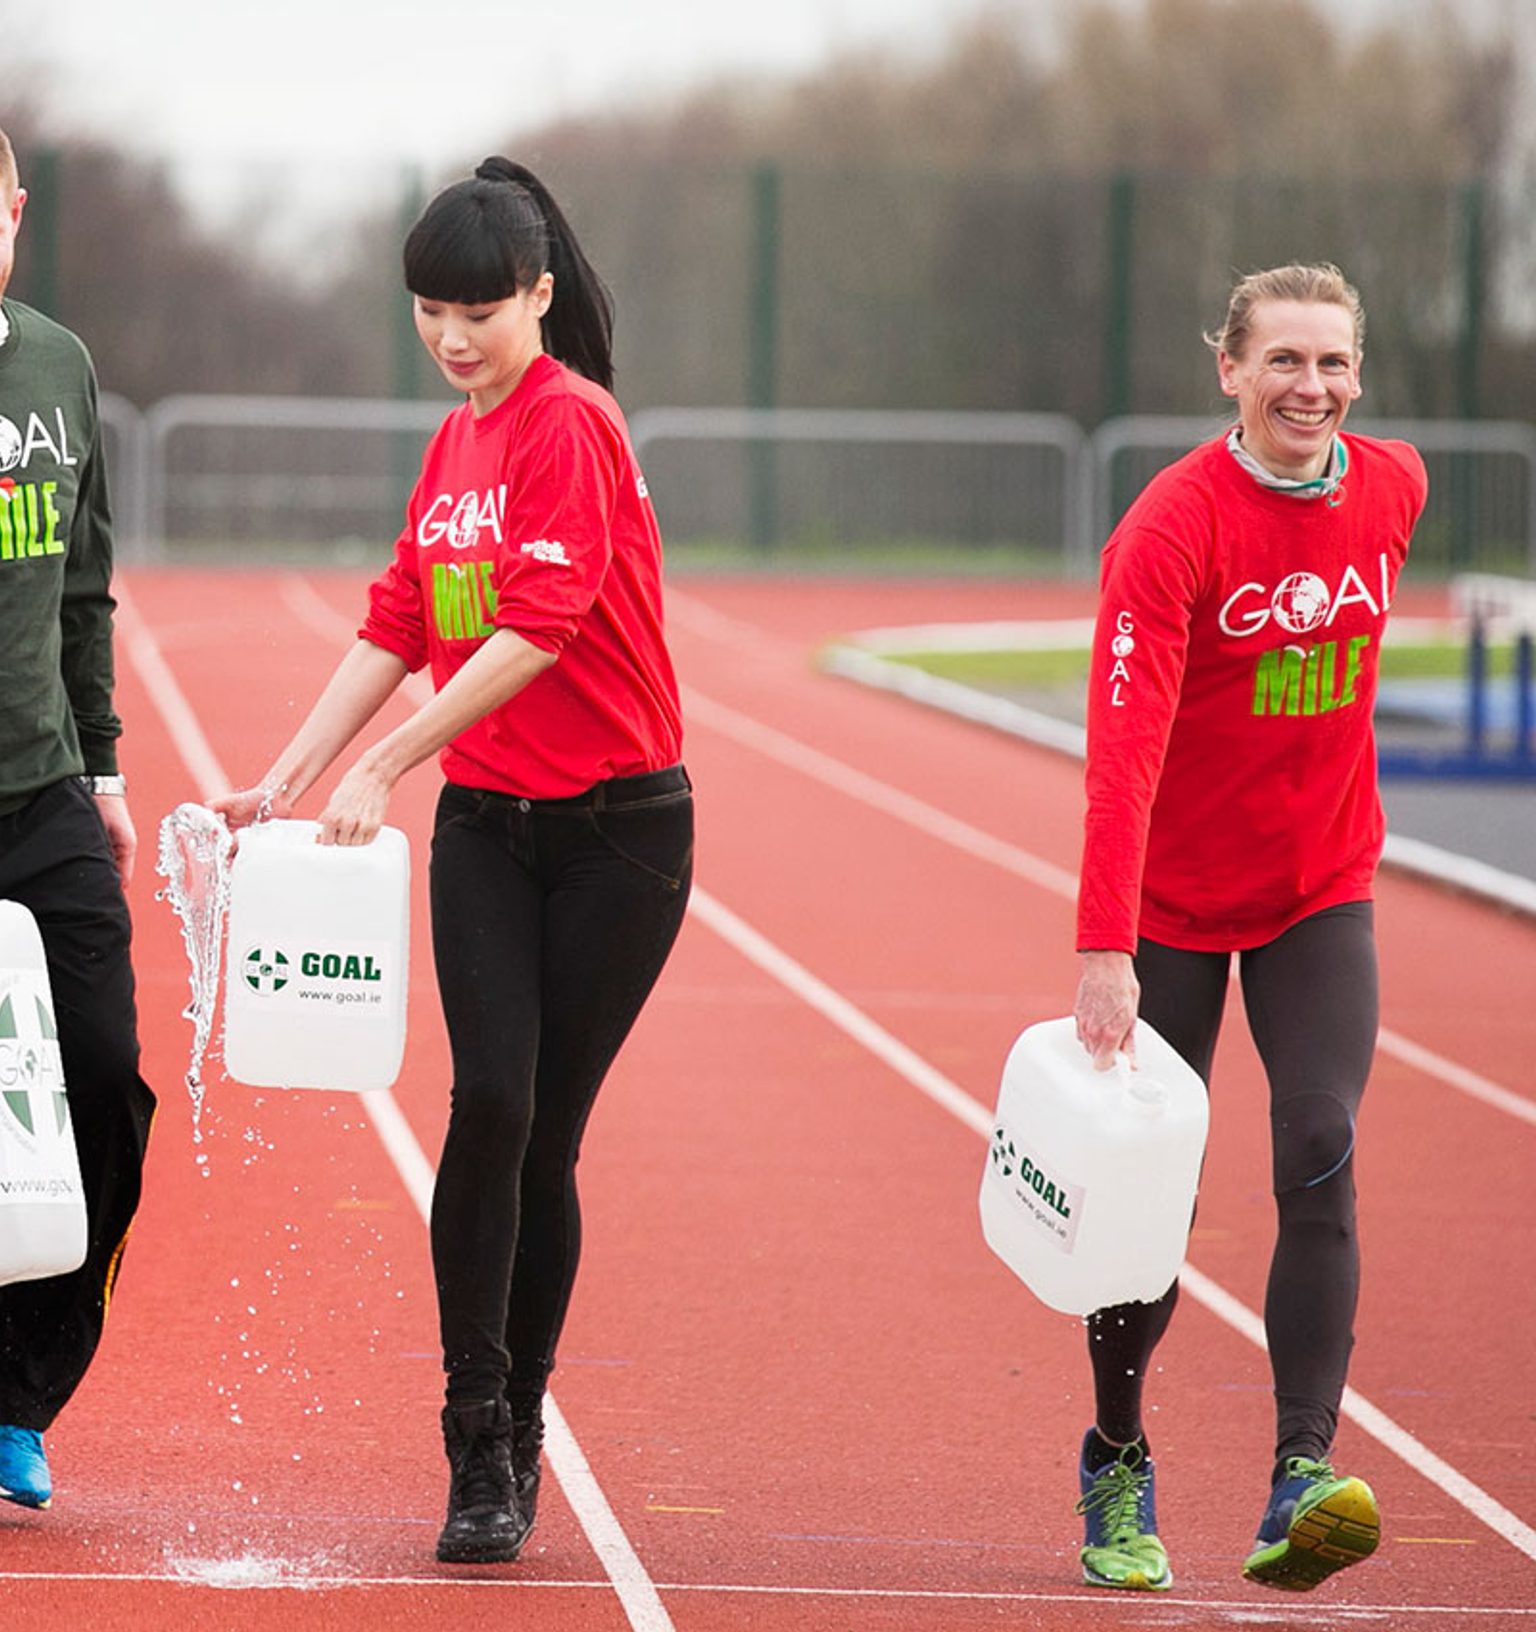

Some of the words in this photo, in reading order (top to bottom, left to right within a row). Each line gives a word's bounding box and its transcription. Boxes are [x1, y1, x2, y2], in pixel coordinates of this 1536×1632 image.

[431, 560, 498, 640] MILE
[1218, 553, 1392, 637] GOAL
[1109, 611, 1135, 706] GOAL
[1252, 634, 1370, 716] MILE
[298, 989, 382, 1004] www.goal.ie
[301, 952, 381, 981] GOAL
[1015, 1188, 1067, 1238] www.goal.ie
[1020, 1156, 1071, 1220] GOAL
